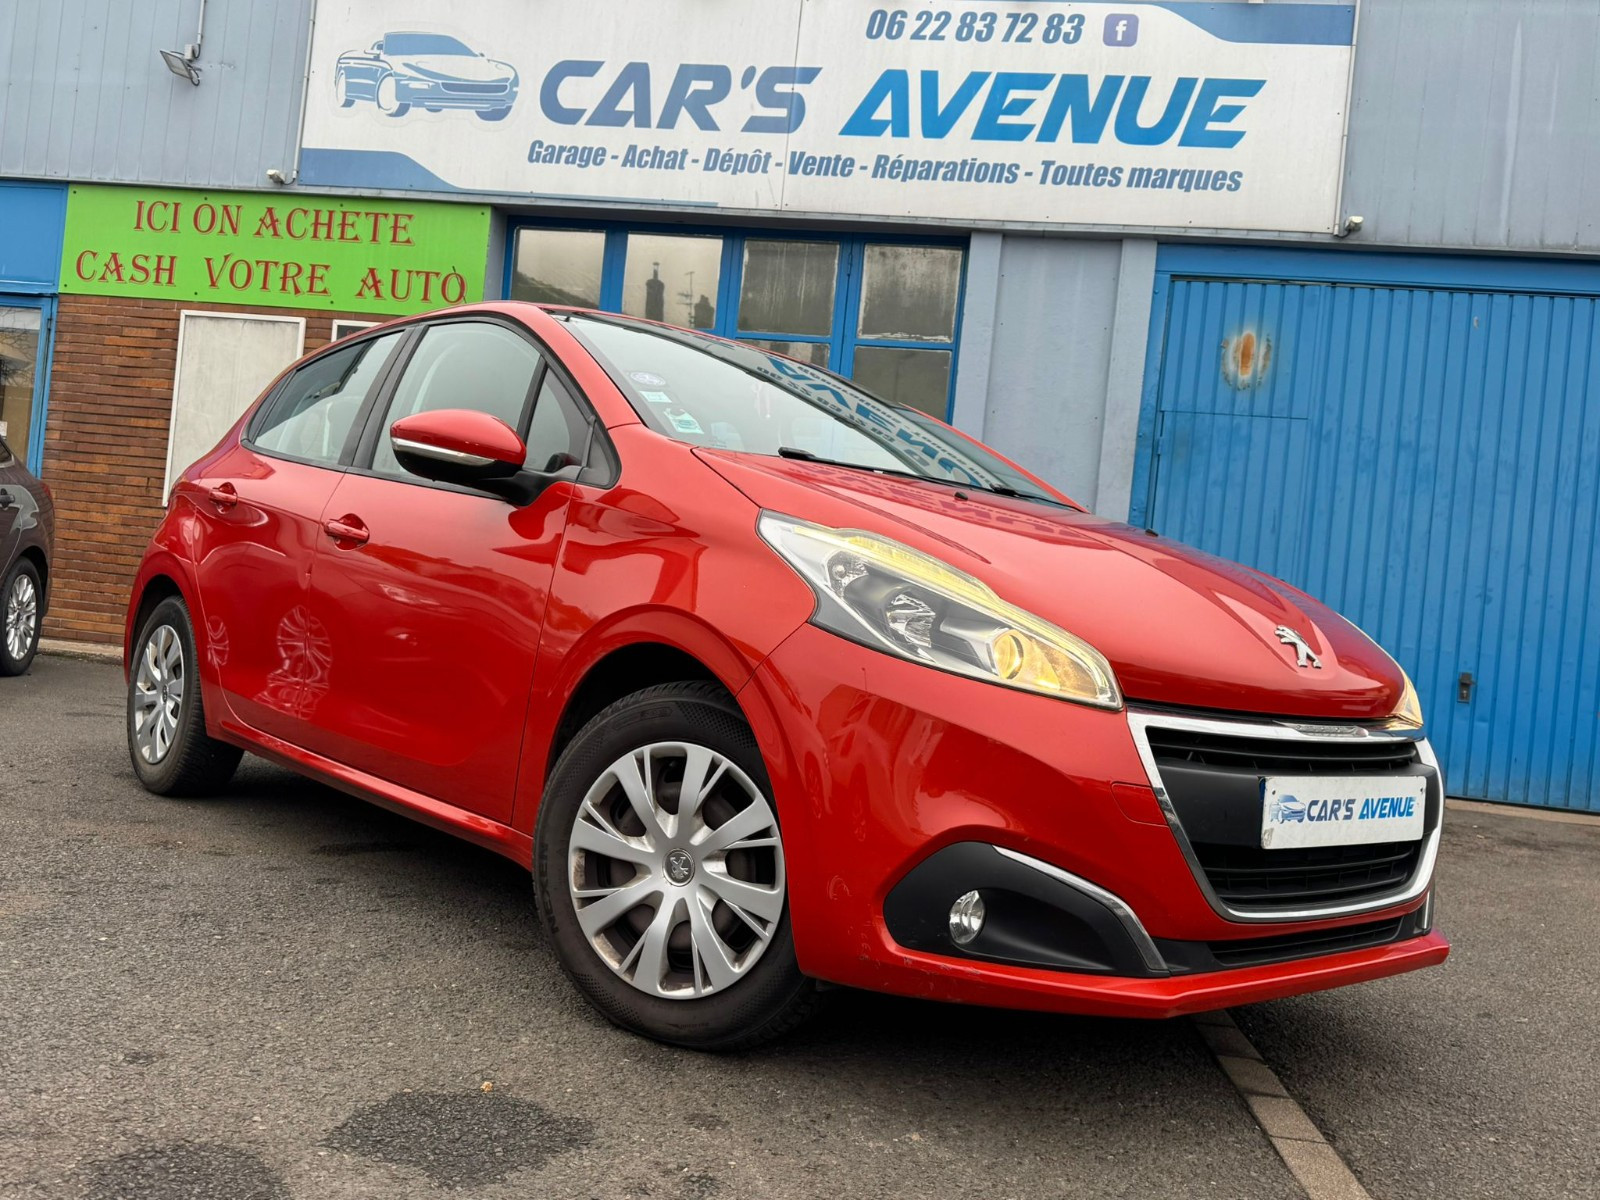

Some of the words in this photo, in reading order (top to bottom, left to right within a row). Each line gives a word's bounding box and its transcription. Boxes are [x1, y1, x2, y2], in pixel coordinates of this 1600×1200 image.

[866, 9, 908, 42] 06
[910, 10, 952, 42] 22
[955, 11, 997, 43] 83
[1002, 12, 1039, 44] 72
[1042, 13, 1086, 45] 83
[539, 59, 823, 134] CAR'S
[838, 68, 1268, 150] AVENUE
[527, 139, 606, 168] Garage
[622, 144, 688, 171] Achat
[703, 147, 772, 176] Dépôt
[788, 151, 856, 178] Vente
[871, 154, 1020, 184] Réparations
[1040, 160, 1124, 187] Toutes
[1127, 168, 1243, 192] marques
[134, 200, 182, 233] ICI
[193, 203, 243, 236] ON
[253, 206, 415, 246] ACHETE
[76, 250, 177, 286] CASH
[204, 253, 332, 296] VOTRE
[354, 267, 469, 305] AUTO
[1306, 799, 1356, 822] CAR'S
[1358, 796, 1417, 820] AVENUE
[538, 842, 561, 934] NEXEN
